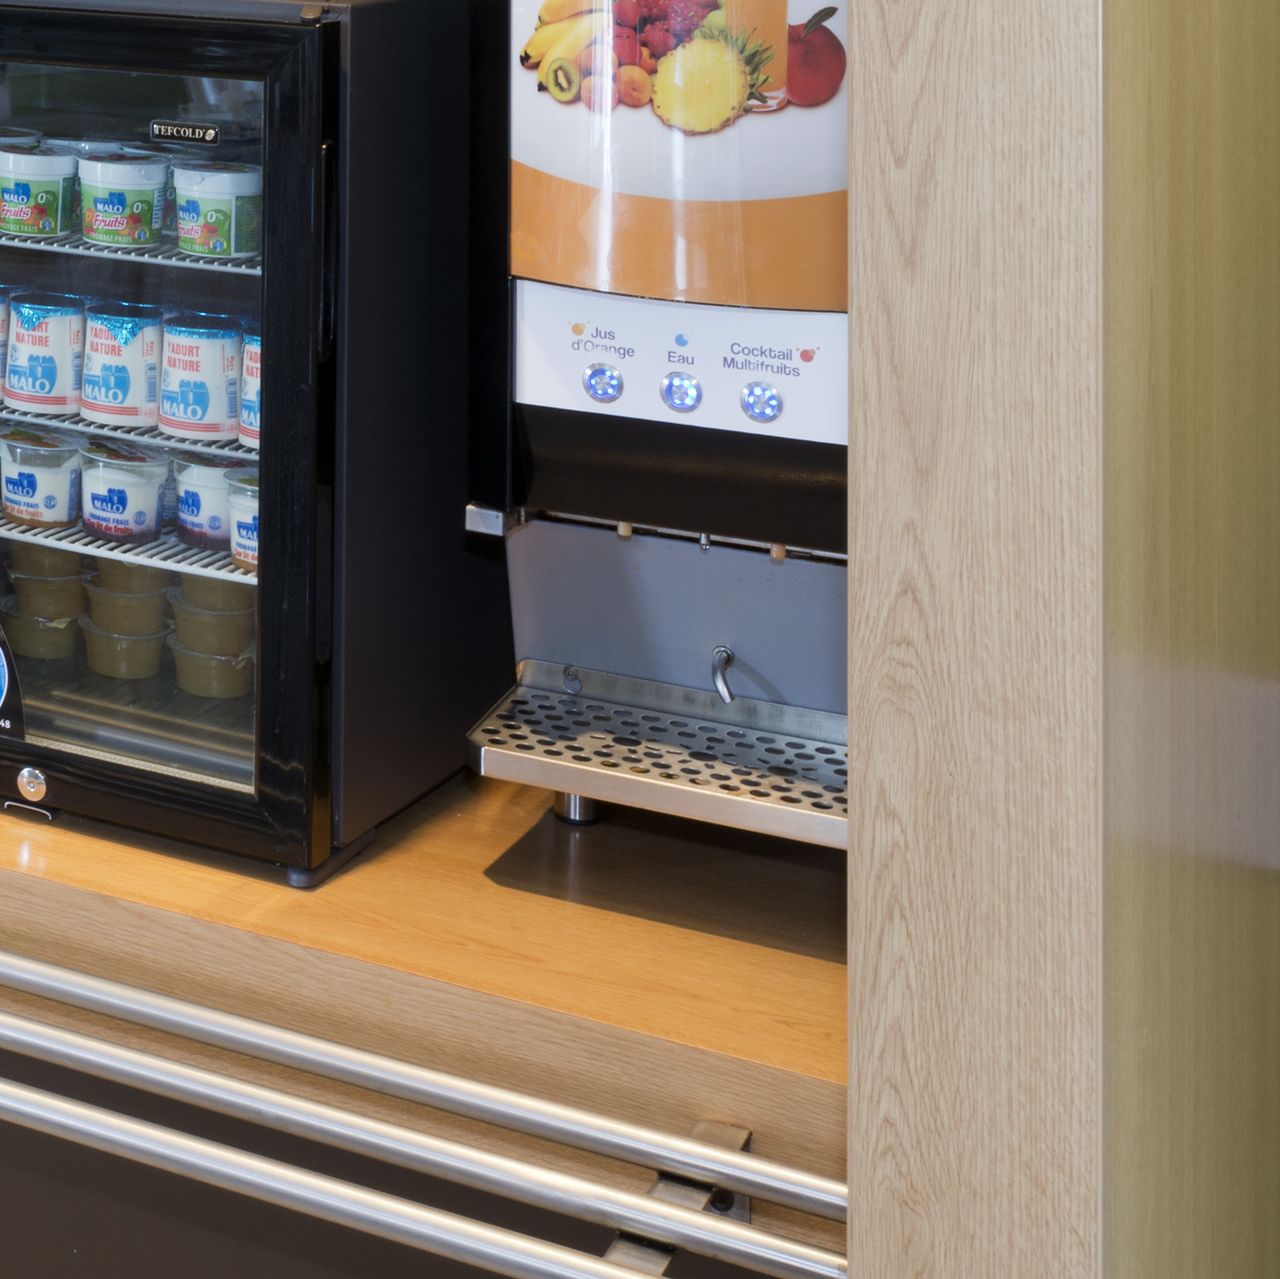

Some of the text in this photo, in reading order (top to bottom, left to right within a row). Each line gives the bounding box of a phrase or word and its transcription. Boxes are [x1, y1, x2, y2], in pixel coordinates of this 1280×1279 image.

[154, 125, 203, 138] TEFCOLD
[3, 193, 27, 204] MALO
[0, 203, 31, 219] Fruits
[96, 202, 122, 213] MALO
[92, 213, 127, 229] Fruits
[15, 332, 49, 347] NATURE
[590, 327, 615, 340] Jus
[90, 339, 123, 357] NATURE
[167, 341, 200, 357] YAOURT
[571, 339, 635, 360] d'Orange
[730, 342, 793, 361] Cocktail
[167, 356, 201, 372] NATURE
[667, 351, 694, 365] Eau
[722, 356, 801, 377] Multifruits
[10, 374, 50, 393] MALO
[85, 384, 123, 403] MALO
[163, 400, 202, 420] MALO
[6, 484, 33, 497] MALO
[94, 498, 123, 514] MALO
[113, 524, 133, 536] fruits
[239, 528, 258, 540] MAL
